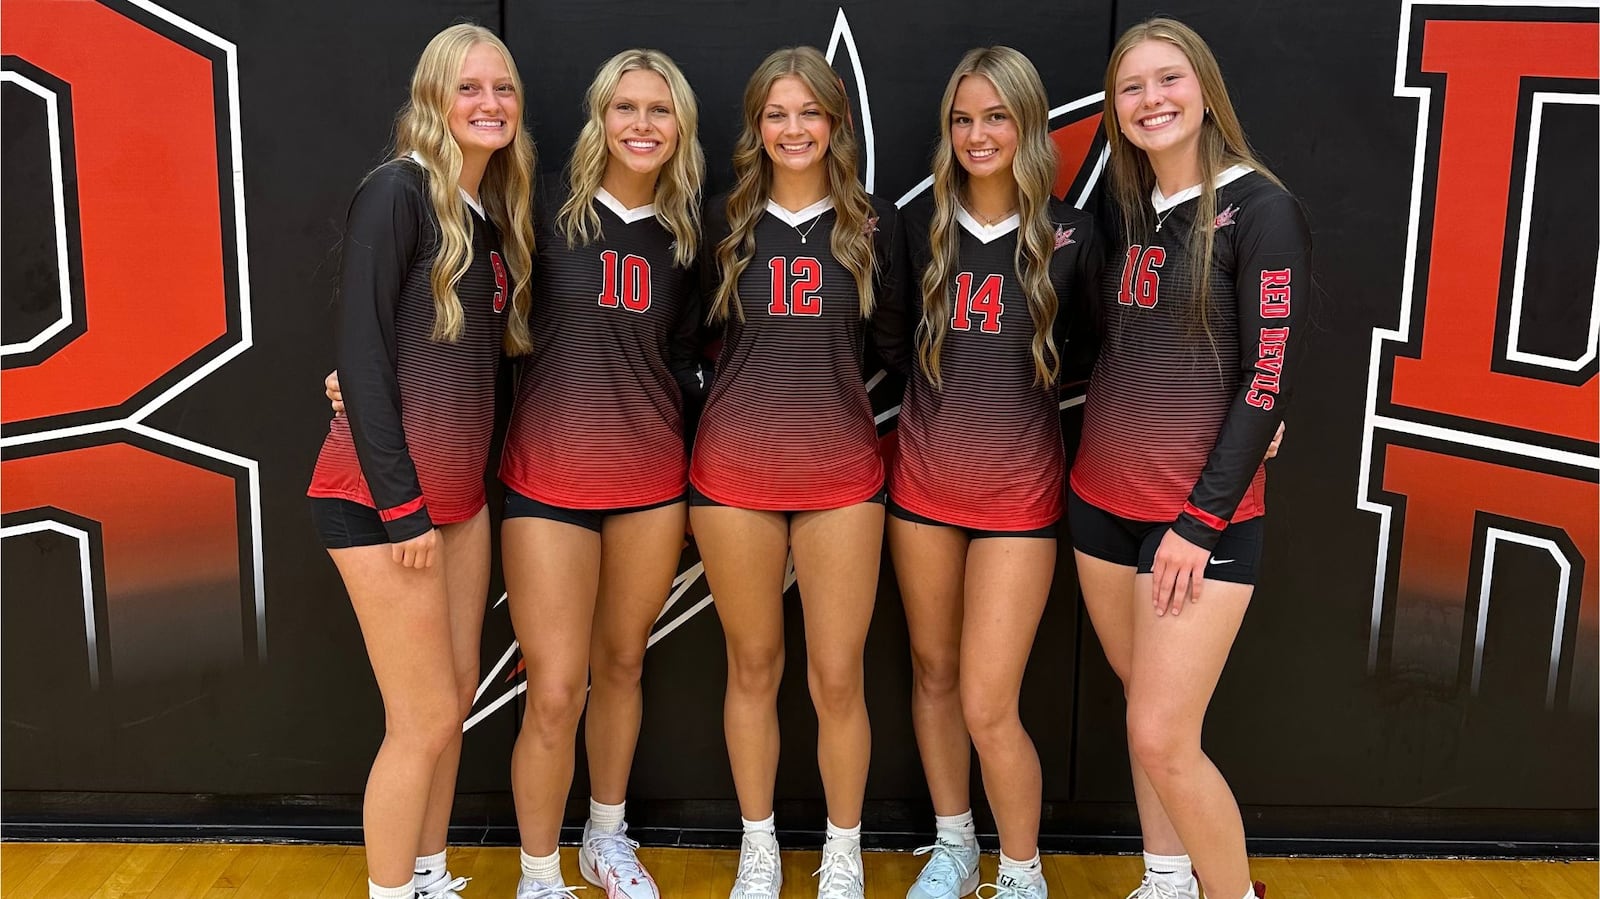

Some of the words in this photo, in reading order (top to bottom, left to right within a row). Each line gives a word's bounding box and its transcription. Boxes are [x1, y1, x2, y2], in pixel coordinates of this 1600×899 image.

[490, 251, 508, 313] 9
[598, 250, 651, 313] 10
[768, 256, 822, 316] 12
[951, 272, 1004, 333] 14
[1118, 244, 1166, 308] 16
[1260, 268, 1291, 318] RED
[1245, 326, 1289, 411] DEVILS
